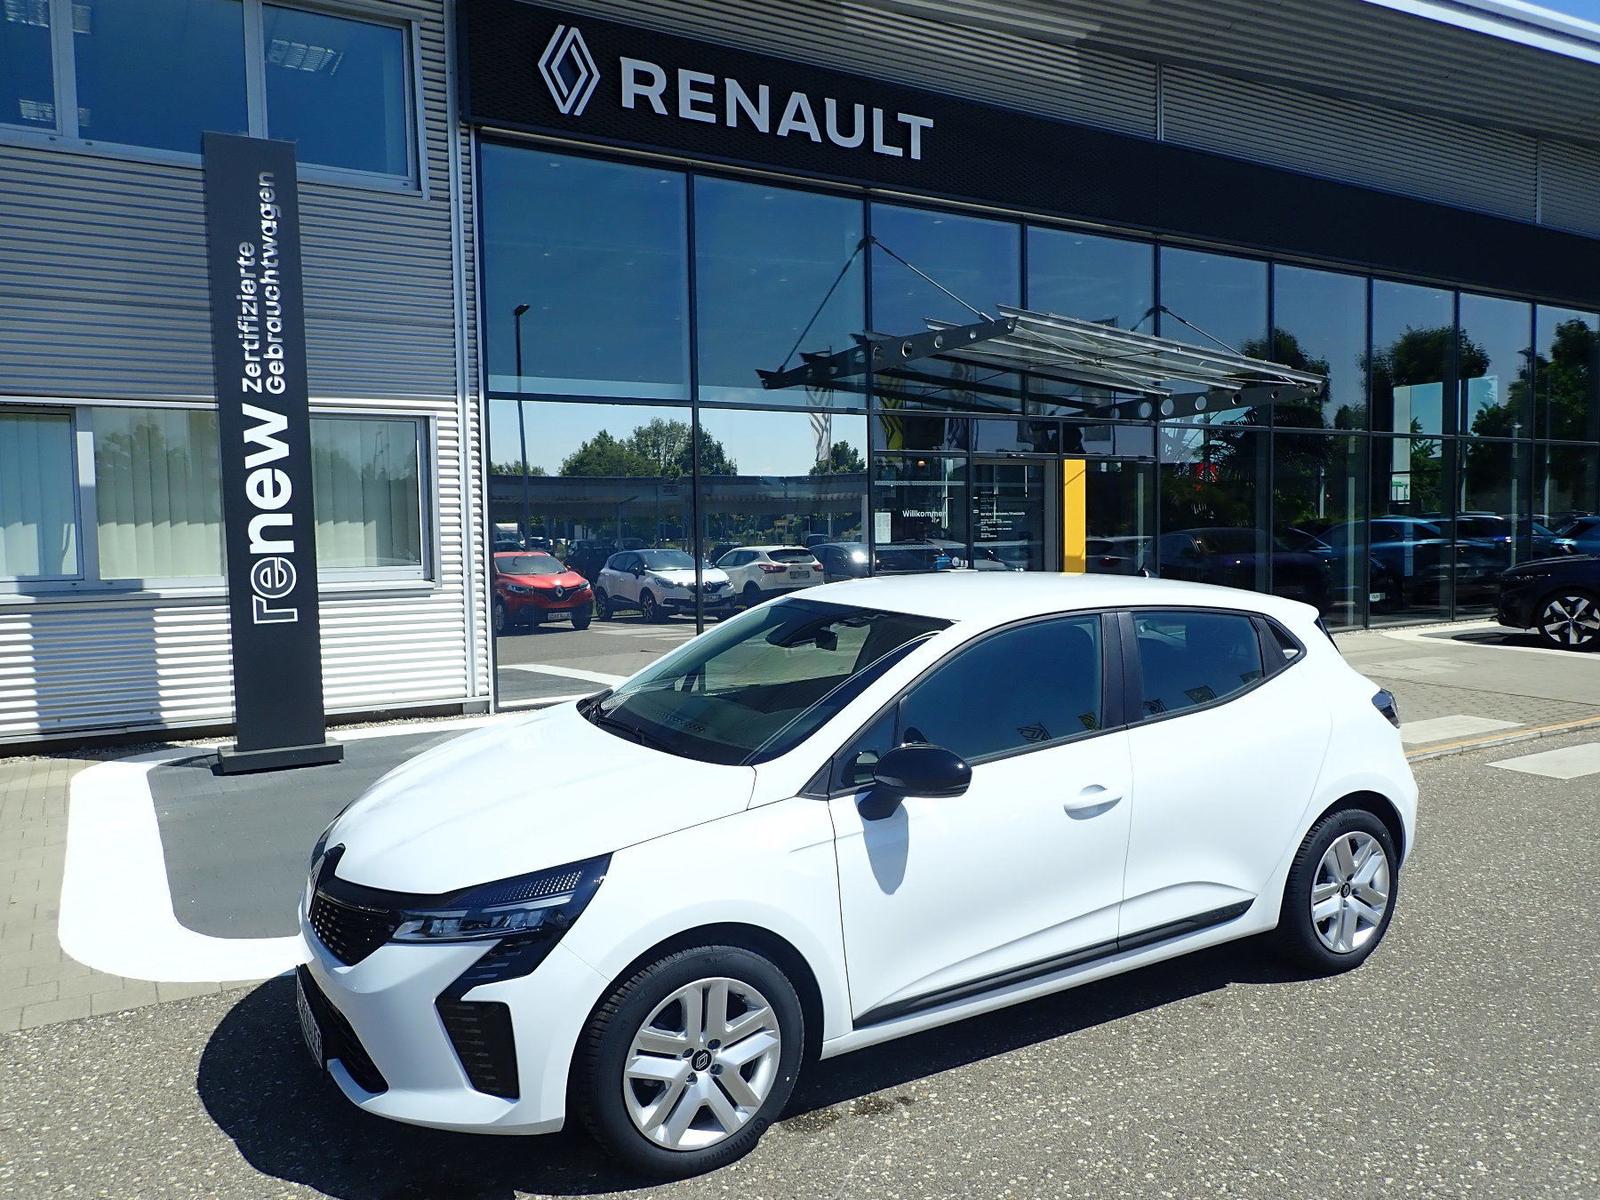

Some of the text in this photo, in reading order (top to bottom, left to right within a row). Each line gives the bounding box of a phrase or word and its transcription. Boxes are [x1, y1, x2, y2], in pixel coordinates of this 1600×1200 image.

[619, 56, 934, 160] RENAULT
[236, 240, 263, 393] Zertifizierte
[257, 171, 286, 396] Gebrauchtwagen
[241, 402, 299, 625] renew
